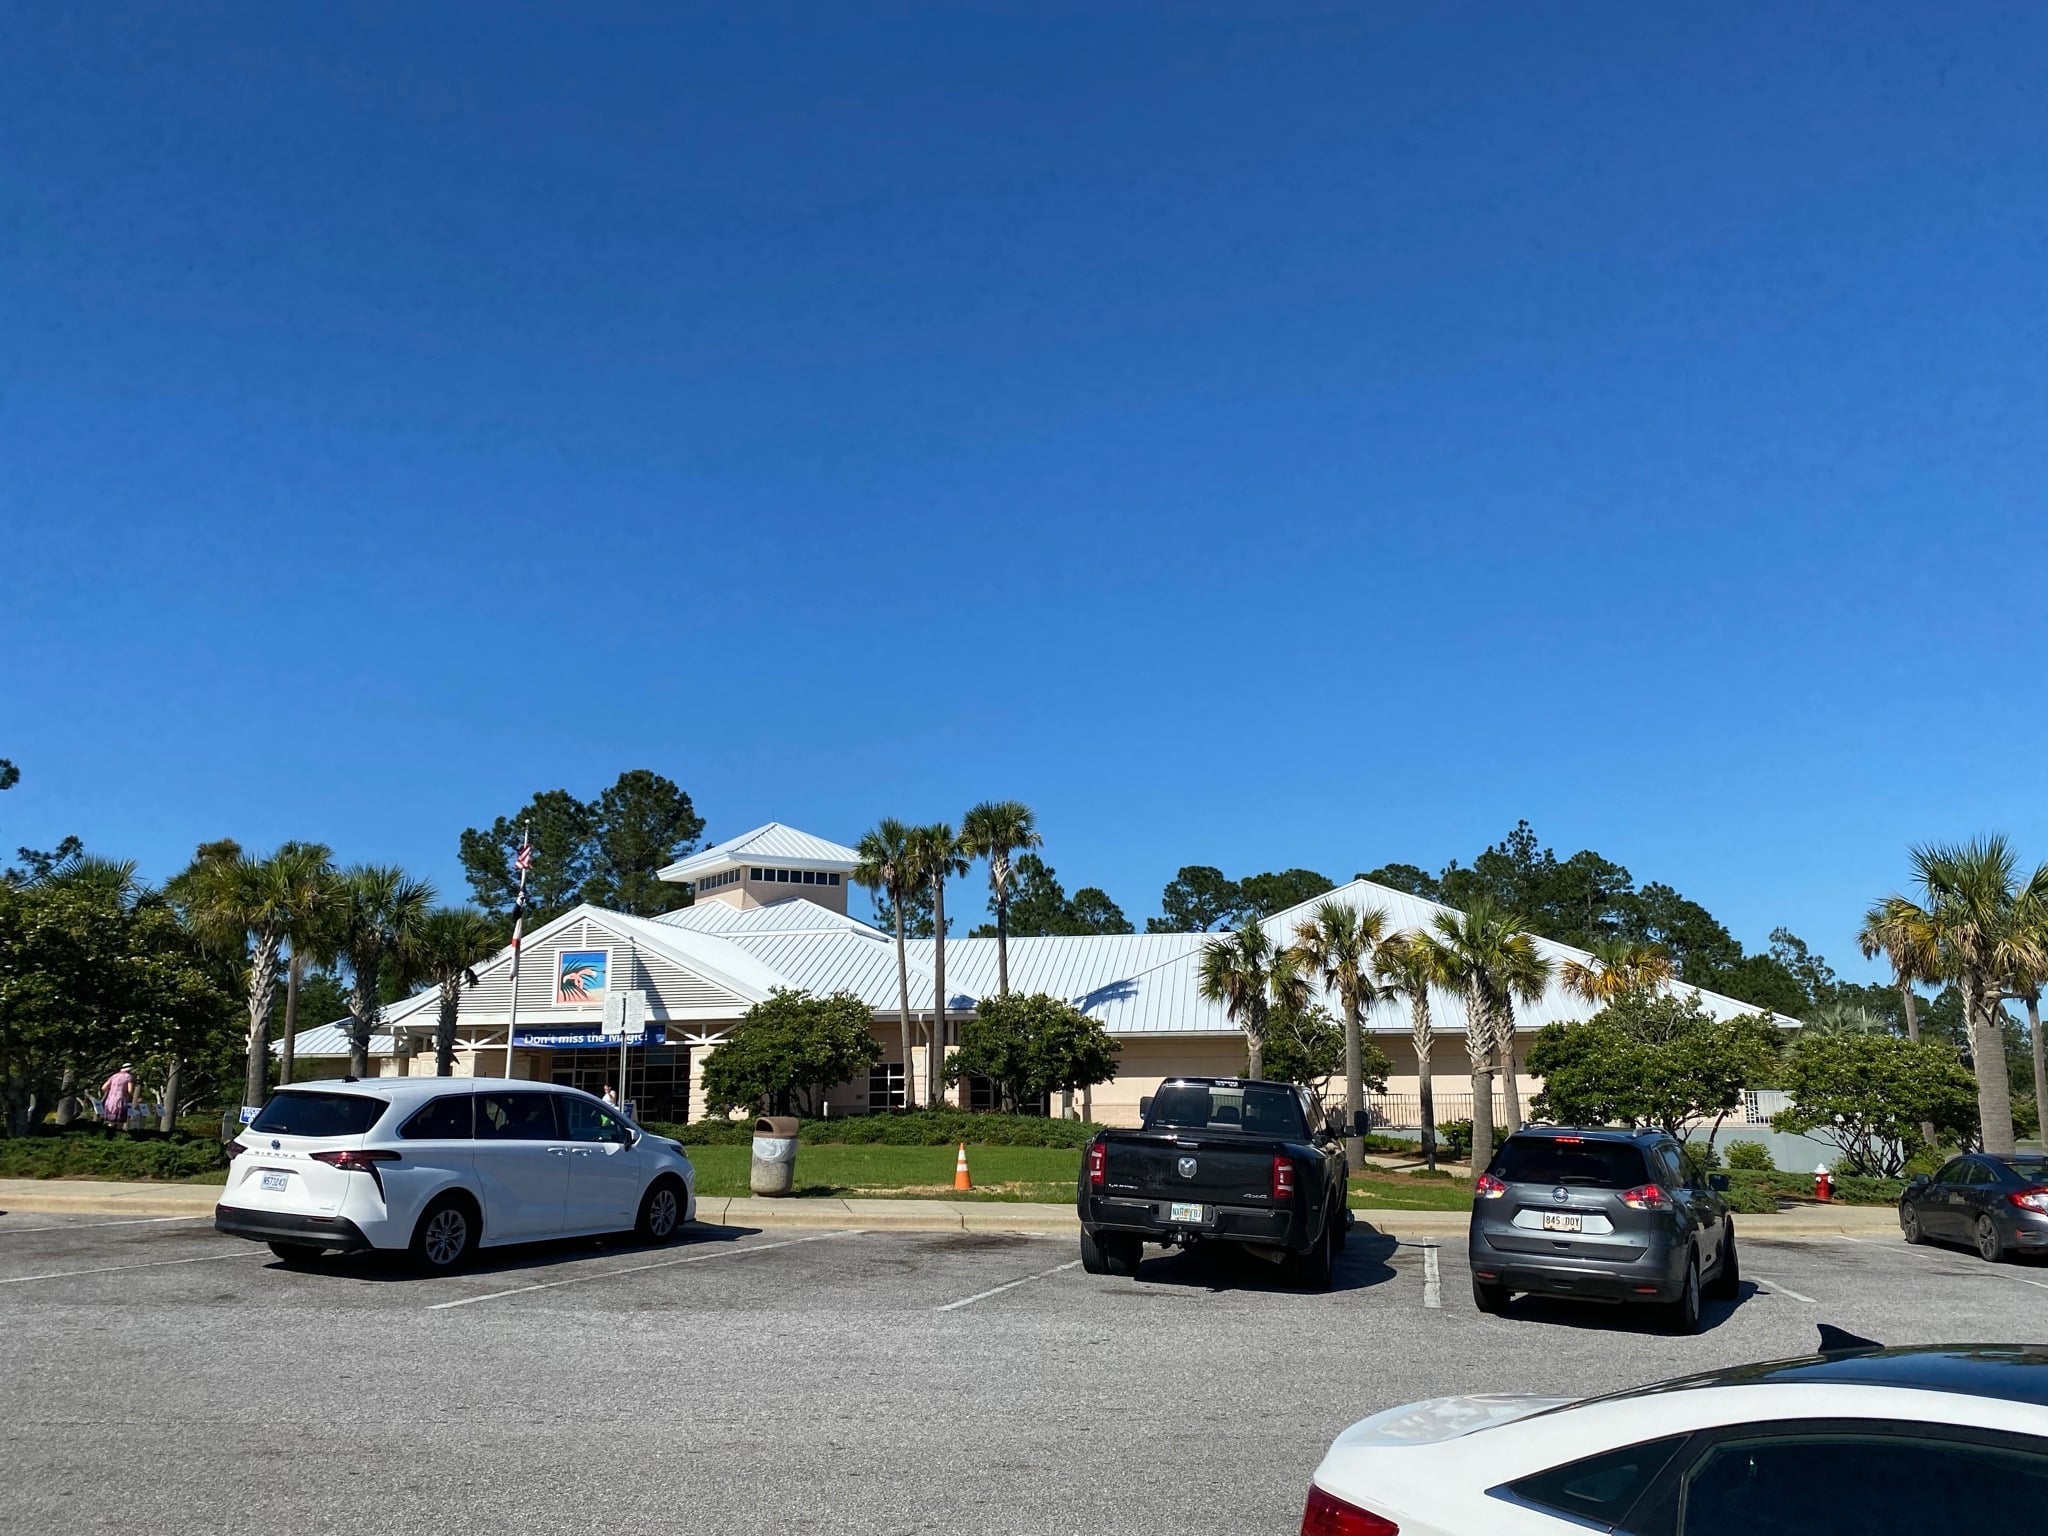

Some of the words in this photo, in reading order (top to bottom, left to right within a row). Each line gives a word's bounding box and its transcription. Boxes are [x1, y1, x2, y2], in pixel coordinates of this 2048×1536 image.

[524, 1033, 555, 1045] Don't
[558, 1032, 584, 1044] miss
[587, 1031, 605, 1043] the
[1546, 1215, 1561, 1225] 845
